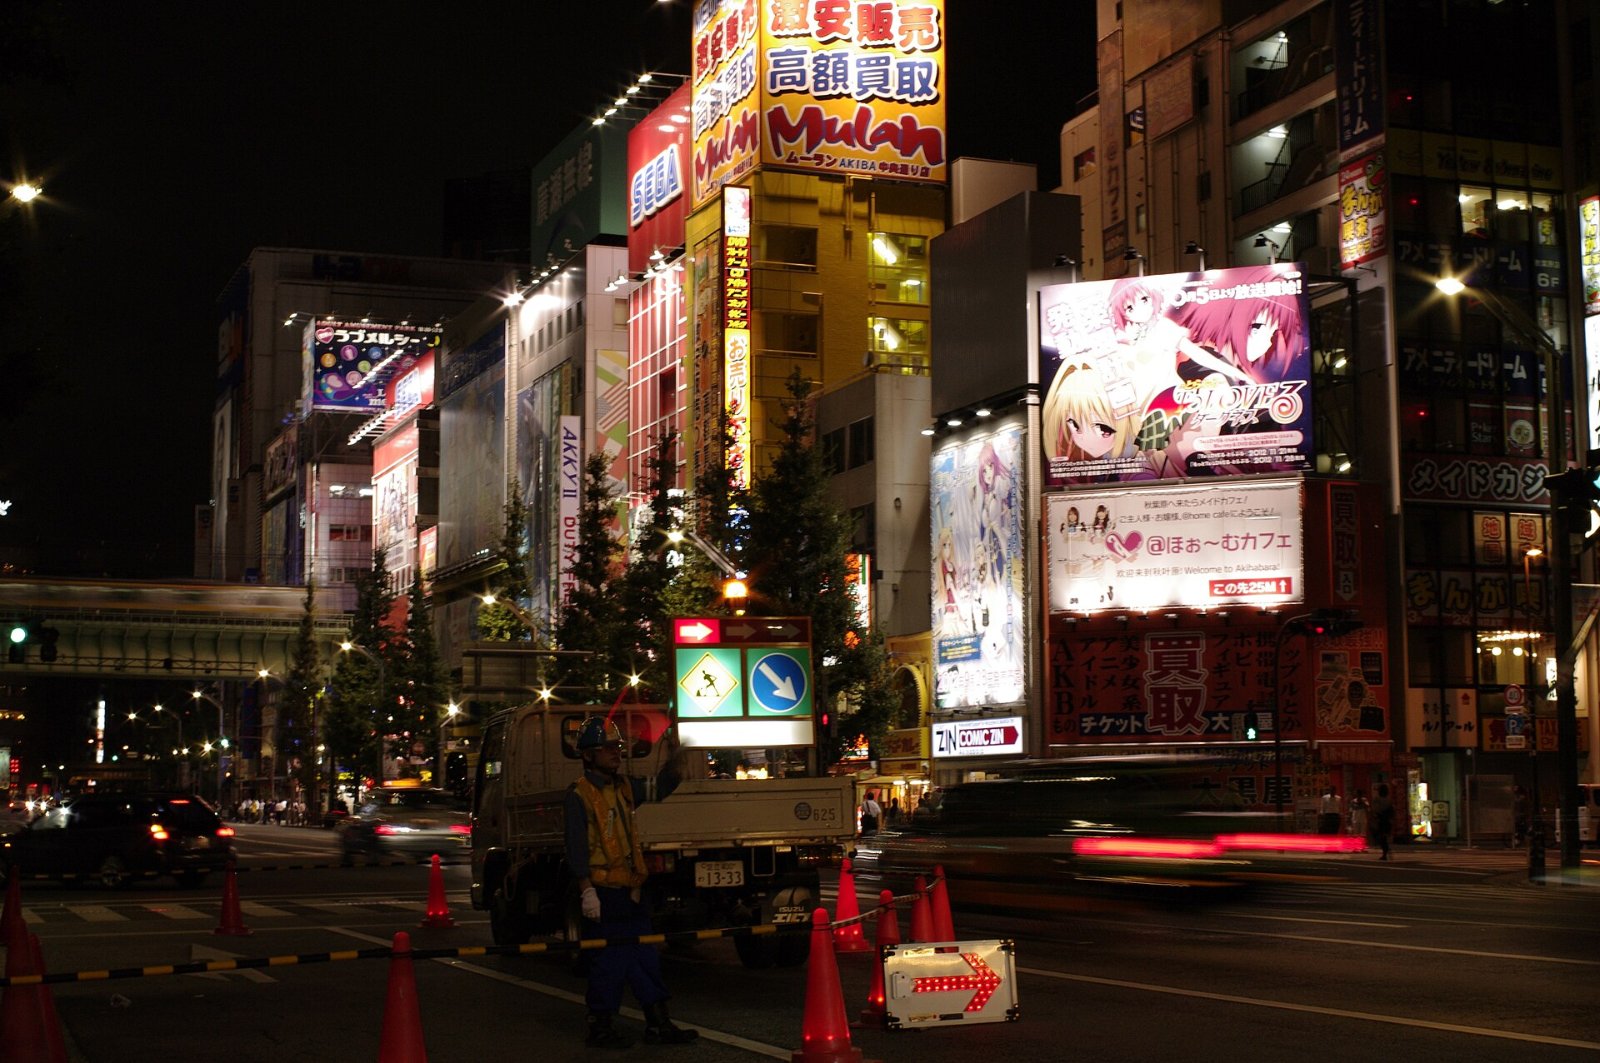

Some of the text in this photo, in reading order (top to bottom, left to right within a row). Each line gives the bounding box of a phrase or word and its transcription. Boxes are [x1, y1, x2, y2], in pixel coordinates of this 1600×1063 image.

[770, 49, 933, 98] 高額買取
[767, 106, 943, 165] Mulan
[632, 146, 680, 222] SEGA
[785, 152, 838, 167] ムーラン
[839, 158, 876, 171] AKIBA
[563, 426, 577, 486] AKKY
[564, 516, 577, 567] DUTY
[1334, 491, 1357, 566] 買取
[1184, 565, 1222, 575] Welcome
[1223, 564, 1233, 574] to
[1079, 637, 1098, 709] アイドル
[1100, 637, 1119, 689] アニメ
[1121, 635, 1142, 711] 美少女系
[1145, 633, 1208, 735] 買取
[1211, 633, 1232, 709] フィギュア
[1234, 632, 1253, 687] ホビー
[936, 724, 957, 755] ZIN
[960, 728, 1004, 746] COMIC ZIN
[1081, 715, 1143, 733] チケット
[1510, 720, 1518, 734] P
[813, 808, 836, 821] 625
[707, 871, 741, 885] 13-33
